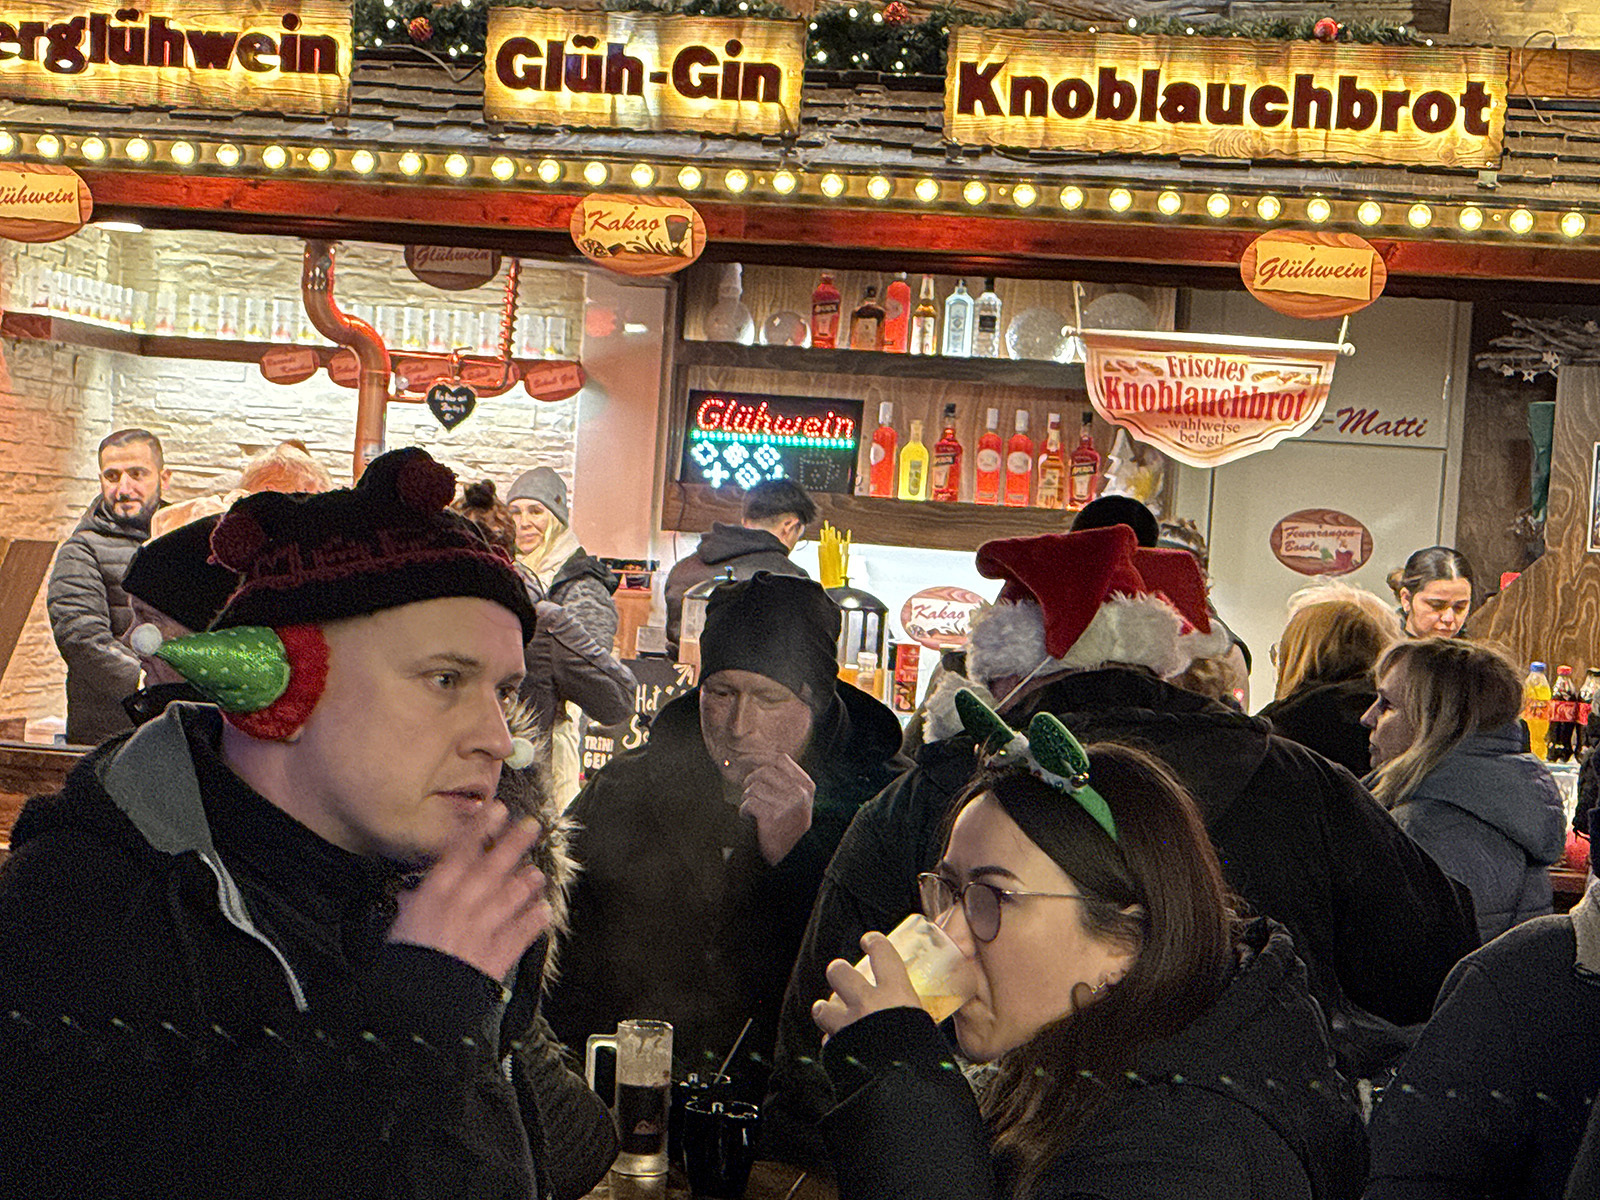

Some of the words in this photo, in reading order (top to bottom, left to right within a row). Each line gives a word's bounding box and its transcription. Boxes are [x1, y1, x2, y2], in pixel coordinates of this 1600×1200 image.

[495, 34, 781, 103] Glüh-Gin
[956, 60, 1492, 136] Knoblauchbrot
[588, 210, 661, 231] Kakao
[416, 246, 490, 267] Glühwein
[1258, 257, 1368, 285] Glühwein
[1166, 355, 1249, 381] Frisches
[1103, 375, 1308, 422] Knoblauchbrot
[696, 397, 855, 439] Glühwein
[1179, 431, 1225, 446] belegt!
[914, 604, 966, 620] Kakao
